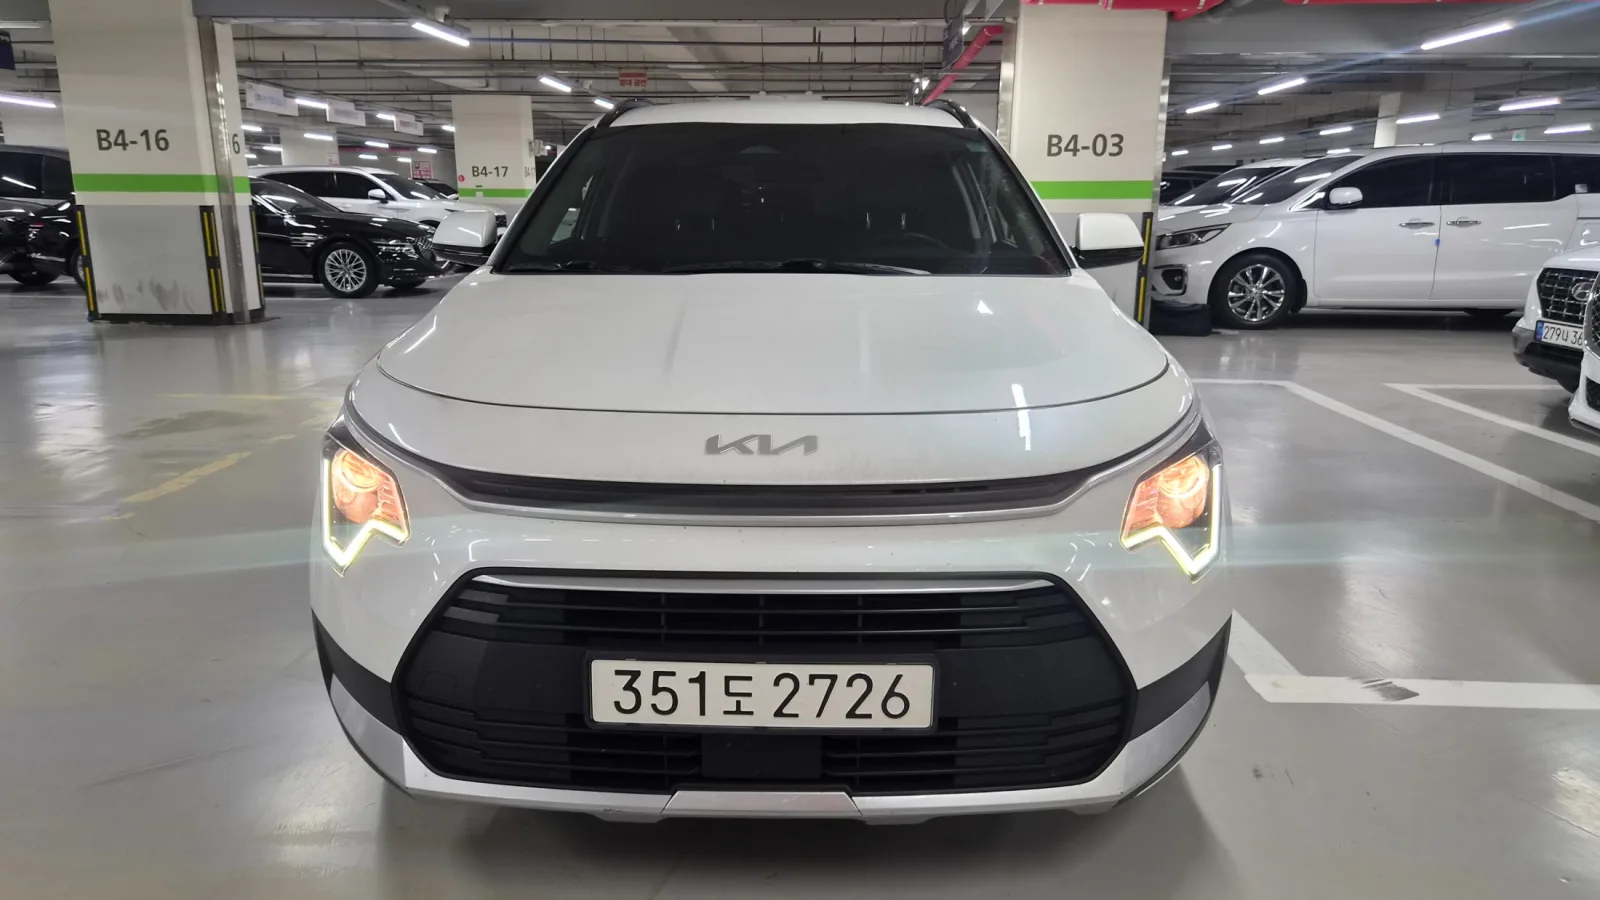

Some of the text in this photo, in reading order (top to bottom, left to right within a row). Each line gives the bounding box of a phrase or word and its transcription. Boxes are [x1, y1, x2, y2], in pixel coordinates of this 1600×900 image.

[96, 128, 170, 152] B4-16
[1046, 133, 1124, 157] B4-03
[471, 165, 509, 178] B4-17
[613, 669, 911, 719] 351도 2726
